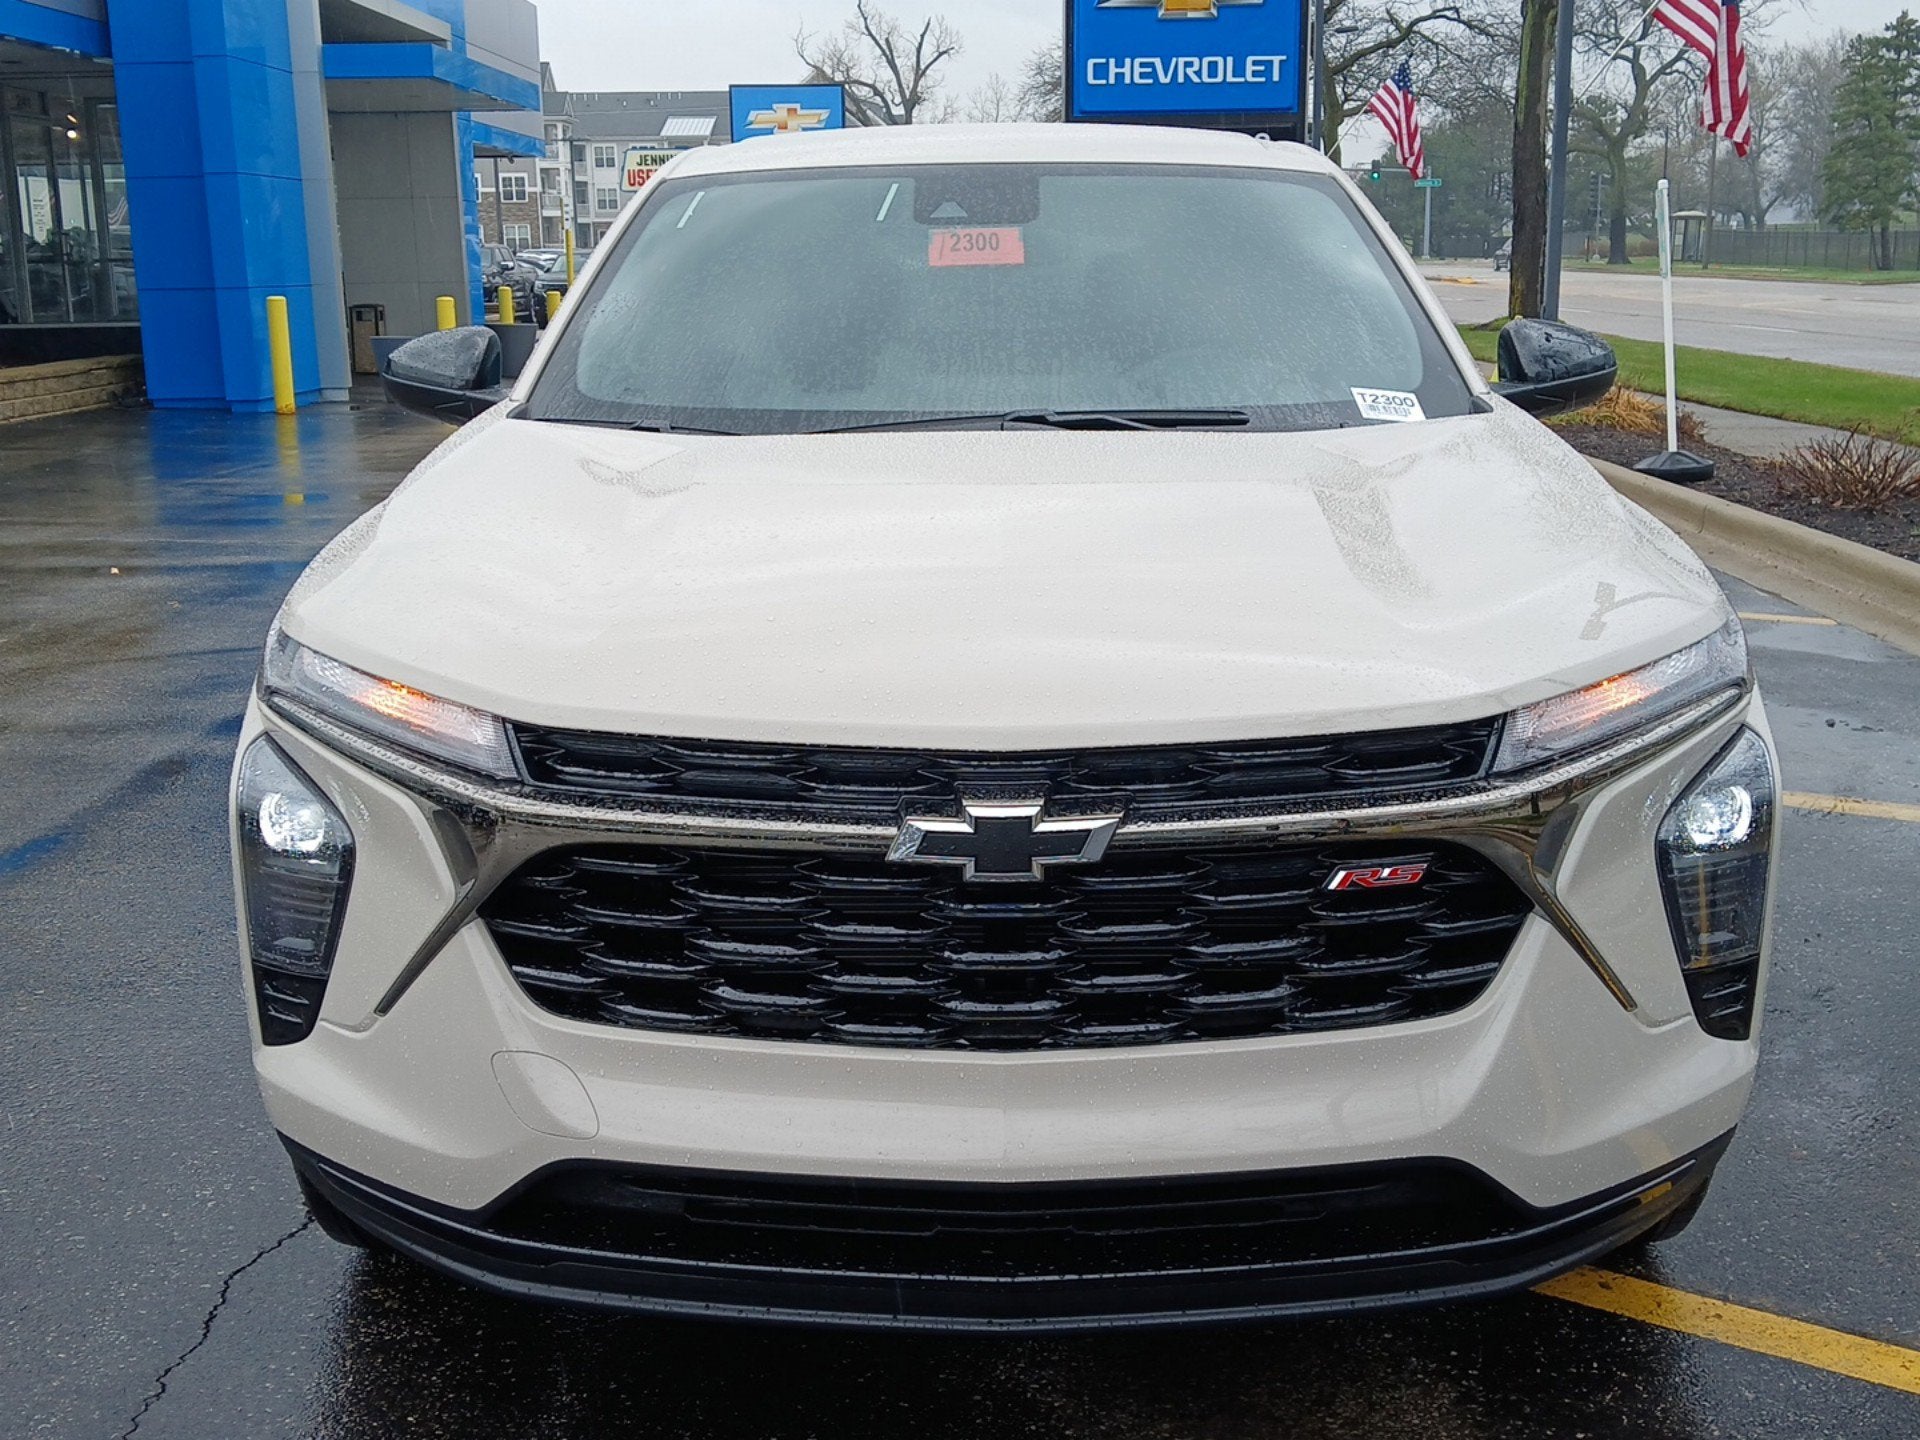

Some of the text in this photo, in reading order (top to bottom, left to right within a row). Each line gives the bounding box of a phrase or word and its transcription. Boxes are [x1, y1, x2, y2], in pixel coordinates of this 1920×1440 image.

[1087, 55, 1287, 85] CHEVROLET
[628, 169, 658, 187] USE
[1356, 392, 1416, 408] T2300
[1327, 863, 1428, 891] RS
